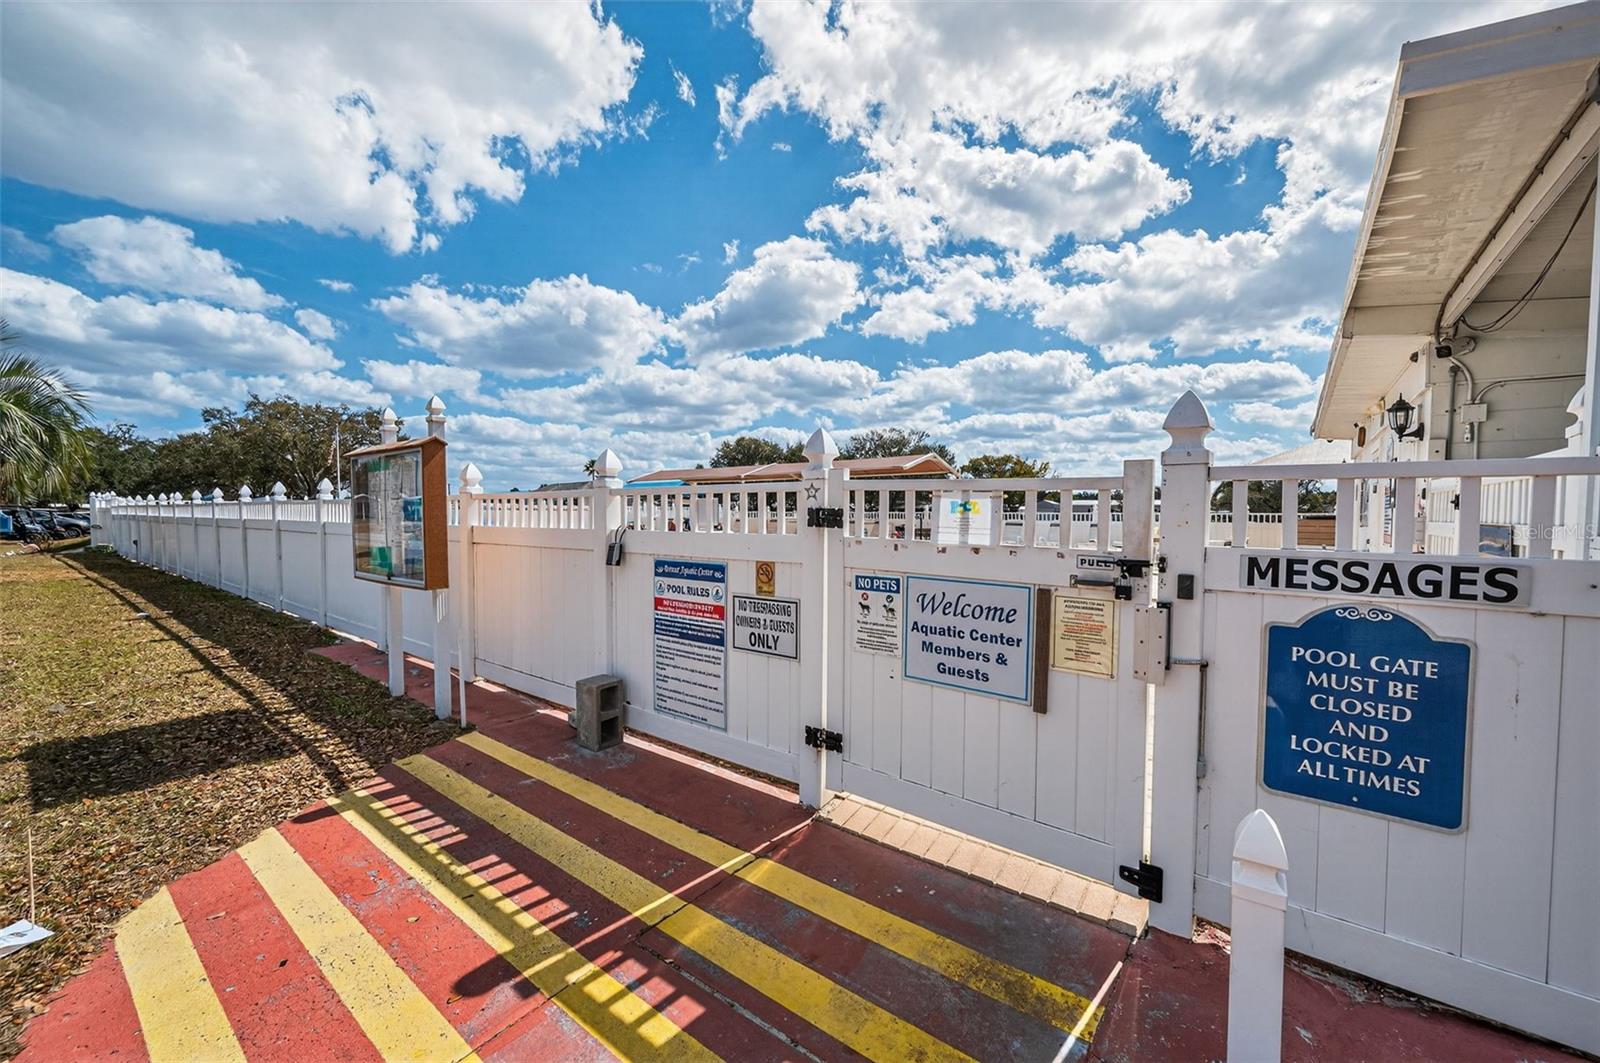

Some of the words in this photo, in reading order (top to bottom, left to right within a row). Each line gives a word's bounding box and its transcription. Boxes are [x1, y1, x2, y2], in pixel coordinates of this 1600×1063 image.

[666, 584, 685, 595] POOL
[687, 586, 710, 598] RULES
[857, 577, 871, 589] NO
[873, 579, 897, 591] PETS
[1246, 556, 1519, 604] MESSAGES
[738, 600, 747, 611] NO
[748, 601, 792, 617] TRESPASSING
[916, 591, 1018, 624] Welcome
[736, 615, 761, 630] OWNERS
[762, 618, 769, 630] &
[769, 619, 795, 634] GUESTS
[911, 620, 966, 642] Aquatic
[969, 628, 1023, 648] Center
[749, 632, 780, 651] ONLY
[921, 640, 991, 664] Members
[995, 651, 1008, 666] &
[936, 662, 990, 683] Guests
[1291, 646, 1361, 670] POOL
[1370, 655, 1439, 679] GATE
[1306, 670, 1379, 695] MUST
[1388, 681, 1419, 701] BE
[1310, 693, 1412, 723] CLOSED
[1328, 719, 1389, 743] AND
[1290, 734, 1392, 767] LOCKED
[1397, 754, 1431, 774] AT
[1296, 759, 1340, 781] ALL
[1344, 767, 1421, 797] TIMES
